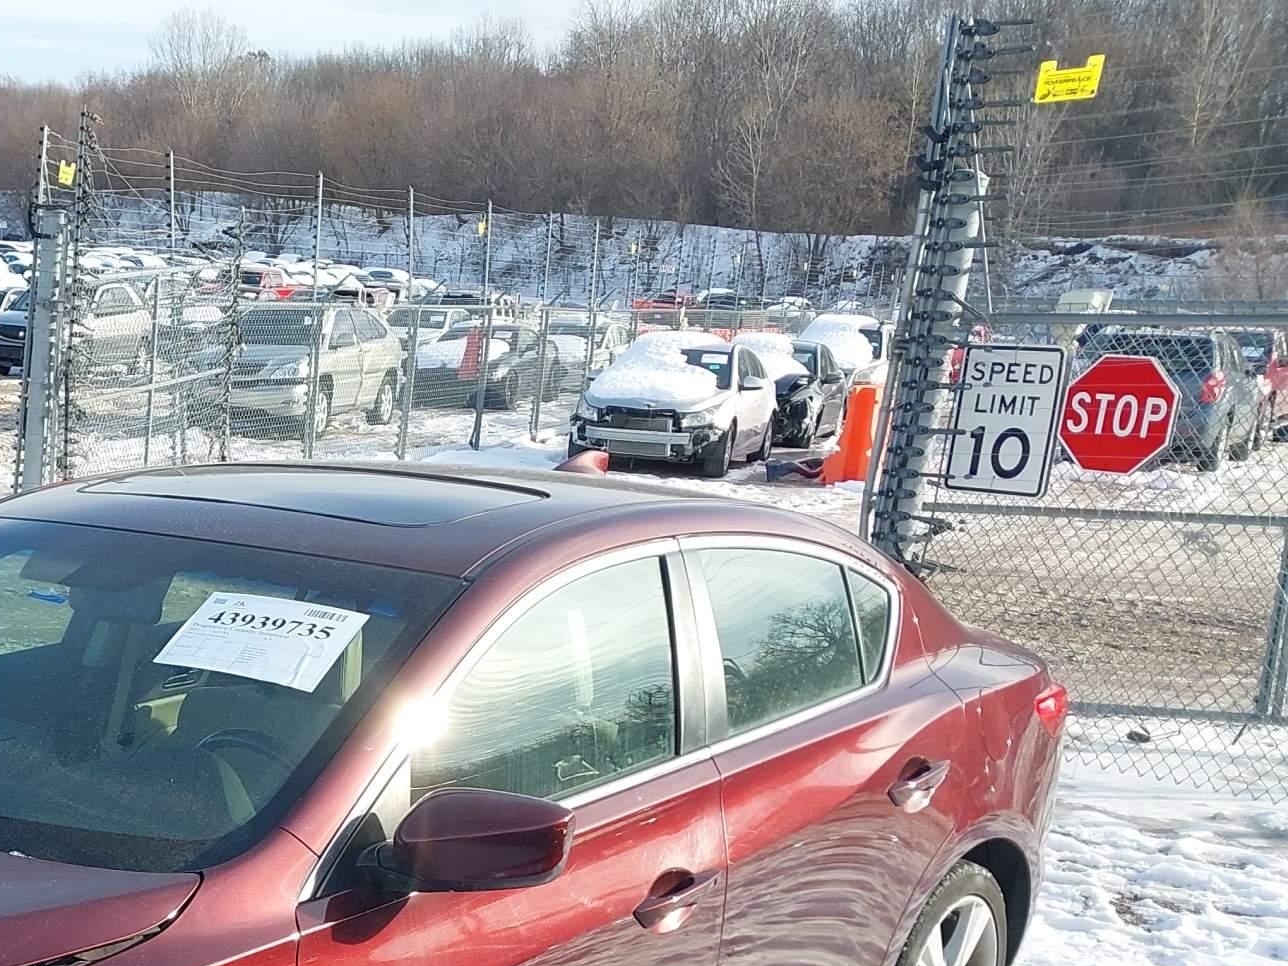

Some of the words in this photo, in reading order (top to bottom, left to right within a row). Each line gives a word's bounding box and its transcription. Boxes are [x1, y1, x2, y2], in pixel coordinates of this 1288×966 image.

[970, 362, 1054, 385] SPEED
[974, 393, 1040, 417] LIMIT
[1066, 391, 1168, 439] STOP
[969, 425, 1031, 480] 10
[208, 611, 336, 640] 43939735
